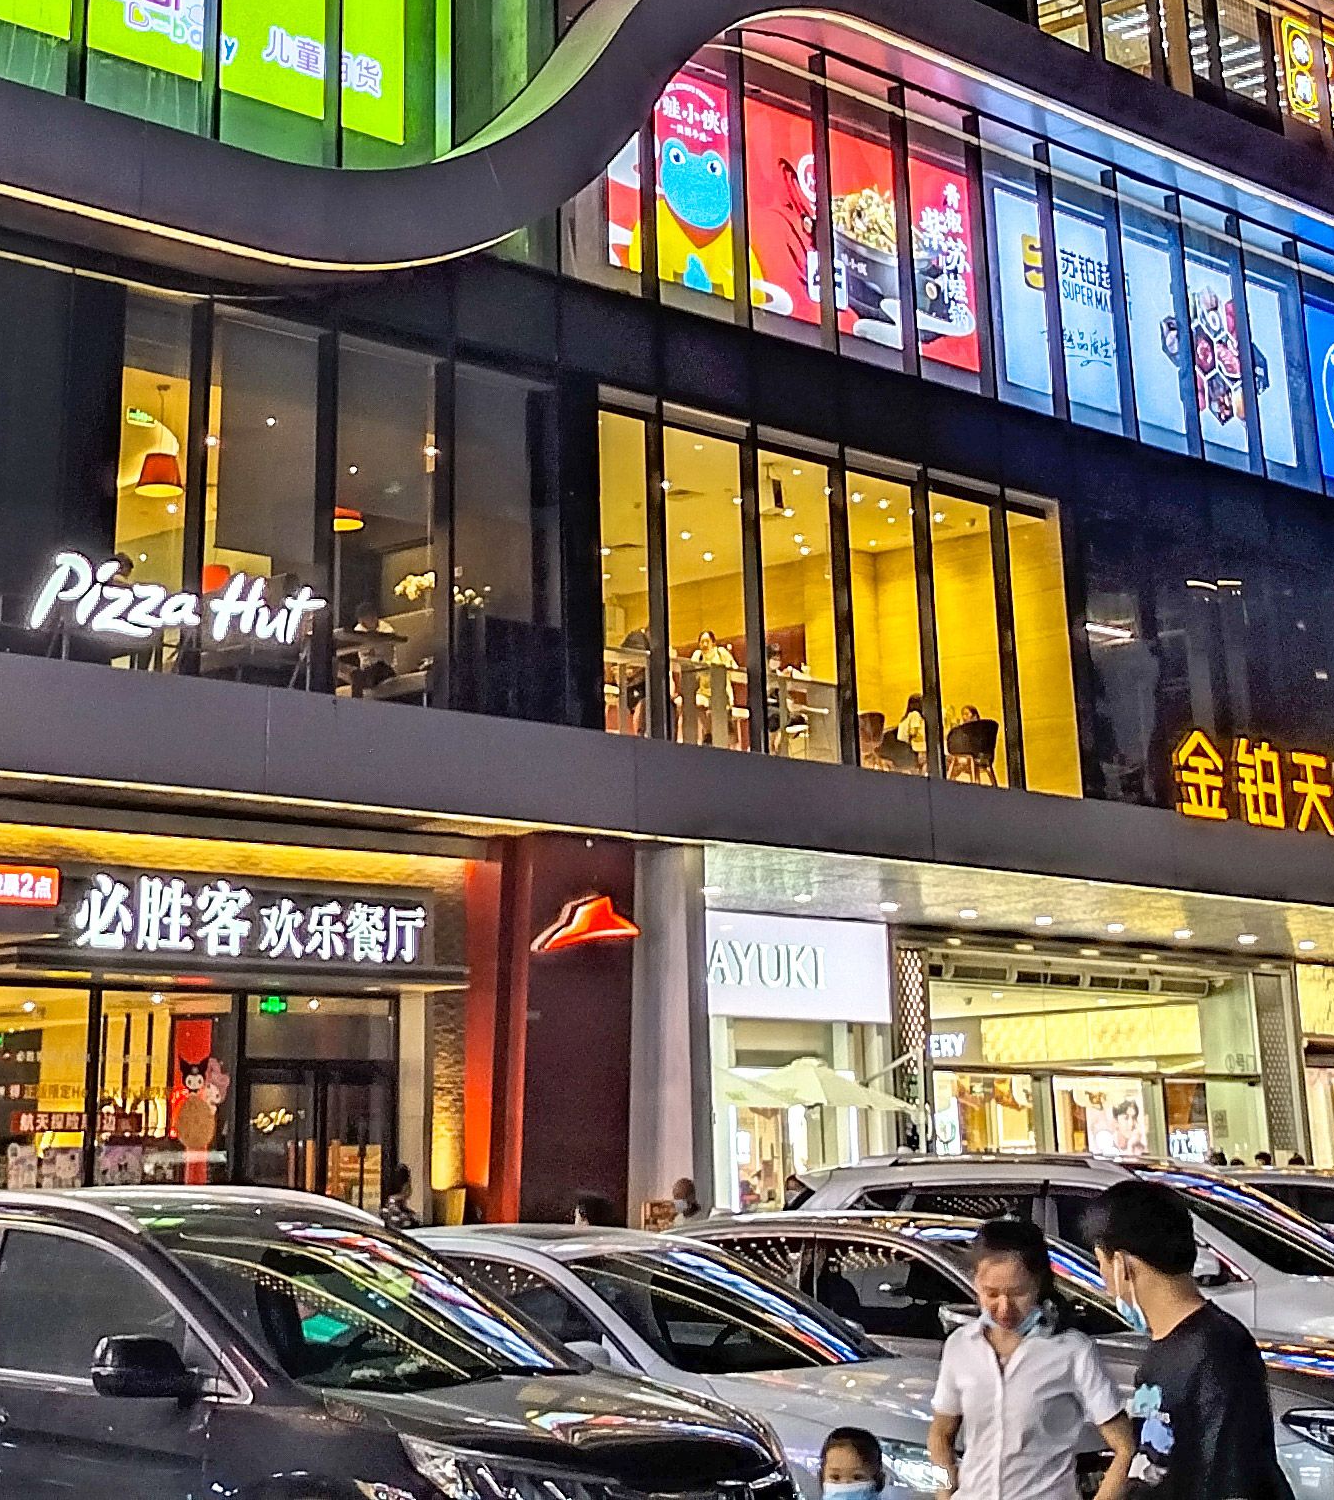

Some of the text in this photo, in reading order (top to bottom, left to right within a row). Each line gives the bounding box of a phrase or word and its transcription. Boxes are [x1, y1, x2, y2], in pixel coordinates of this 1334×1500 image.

[28, 551, 329, 646] Pizza Hut
[74, 873, 426, 963] 必胜客 欢乐餐厅
